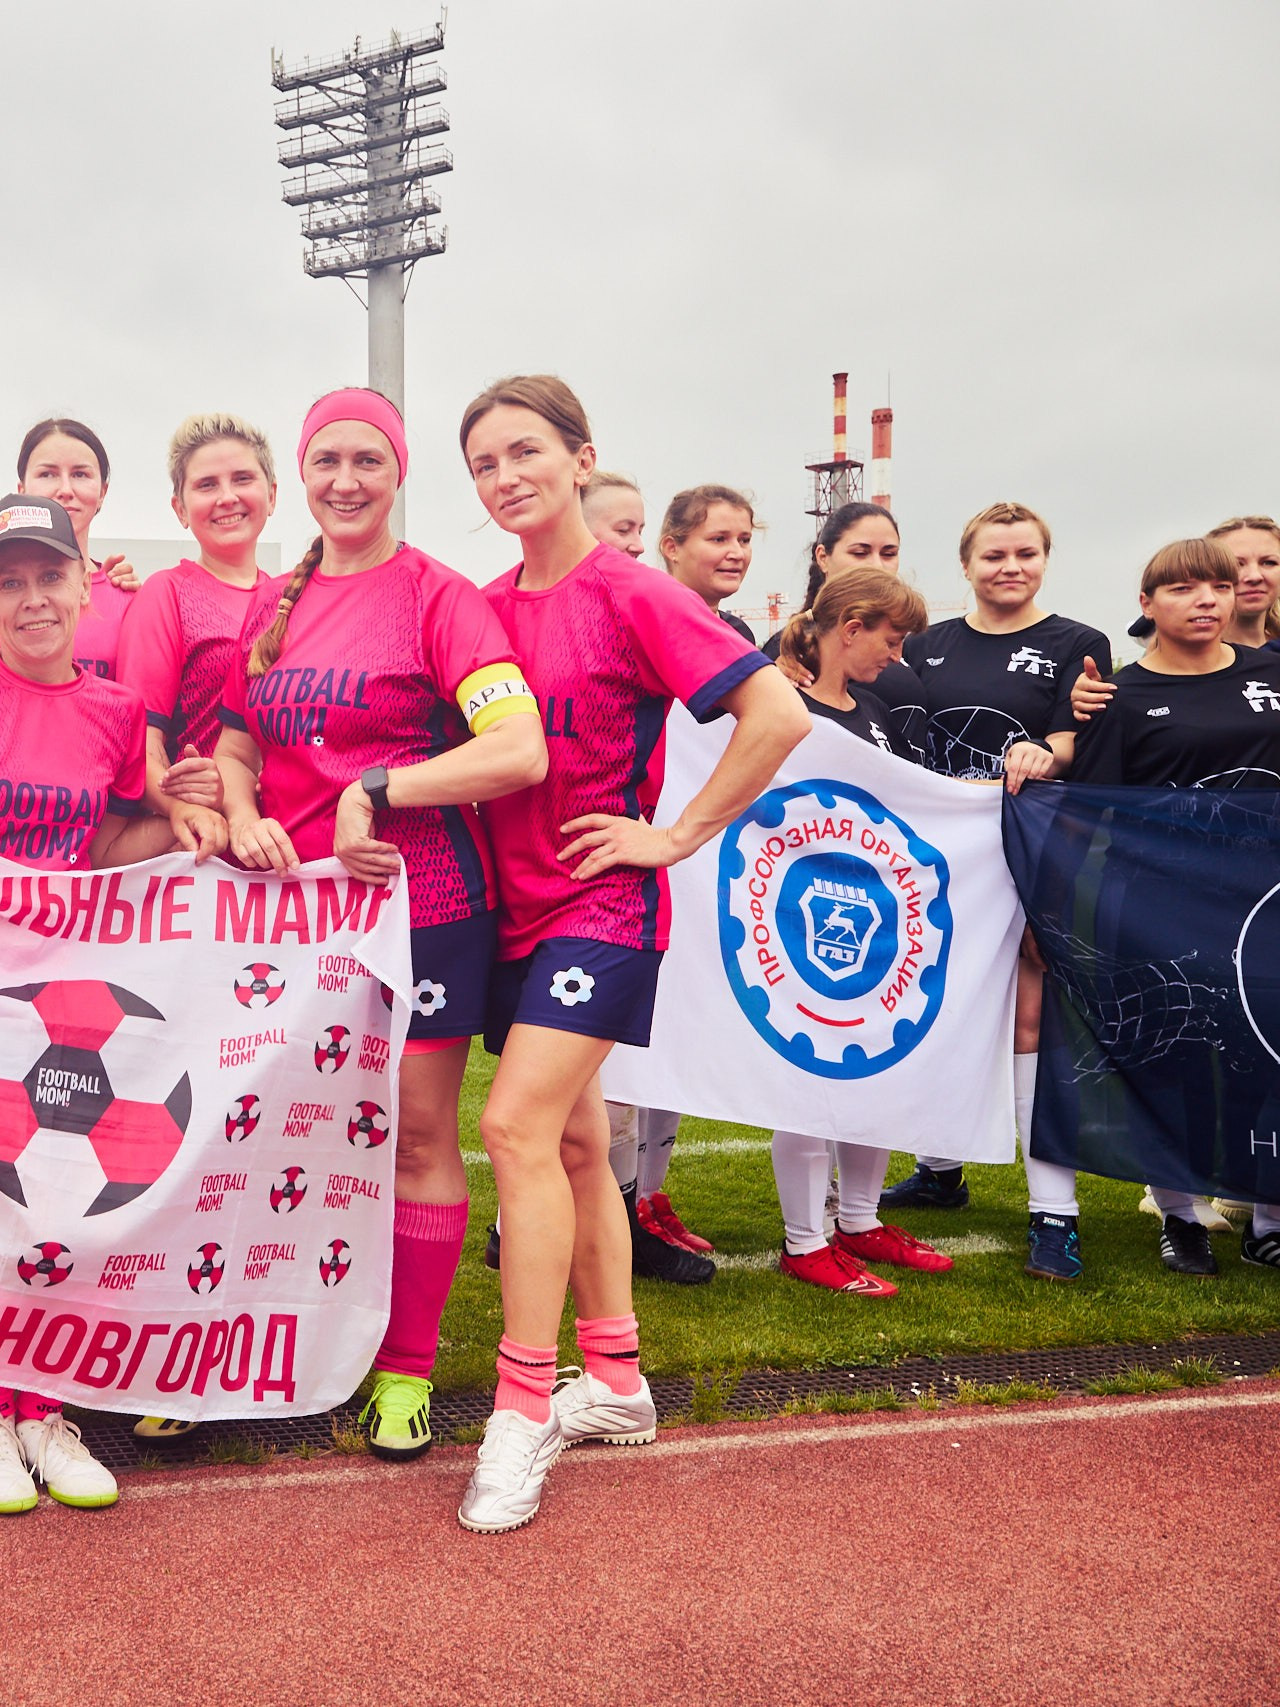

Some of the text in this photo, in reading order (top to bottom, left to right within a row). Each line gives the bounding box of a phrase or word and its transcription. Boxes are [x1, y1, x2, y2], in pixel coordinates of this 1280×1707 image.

[246, 667, 371, 711] OOTBALL
[256, 706, 328, 747] MOM!
[0, 820, 86, 864] MOM!
[748, 817, 923, 1013] ПРОФСОЮЗНАЯ ОРГАНИЗАЦИЯ
[317, 973, 348, 994] MOM!
[219, 1028, 288, 1054] FOOTBALL
[219, 1049, 256, 1069] MOM!
[37, 1067, 101, 1095] FOOTBALL
[35, 1086, 72, 1107] MOM!
[288, 1102, 336, 1122] FOOTBALL
[282, 1121, 313, 1138] MOM!
[200, 1173, 248, 1193] FOOTBALL
[326, 1174, 380, 1200] FOOTBALL
[195, 1194, 224, 1212] MOM!
[323, 1192, 351, 1210] MOM!
[104, 1252, 166, 1273] FOOTBALL
[247, 1243, 296, 1262] FOOTBALL
[97, 1272, 136, 1290] MOM!
[243, 1262, 271, 1281] MOM!
